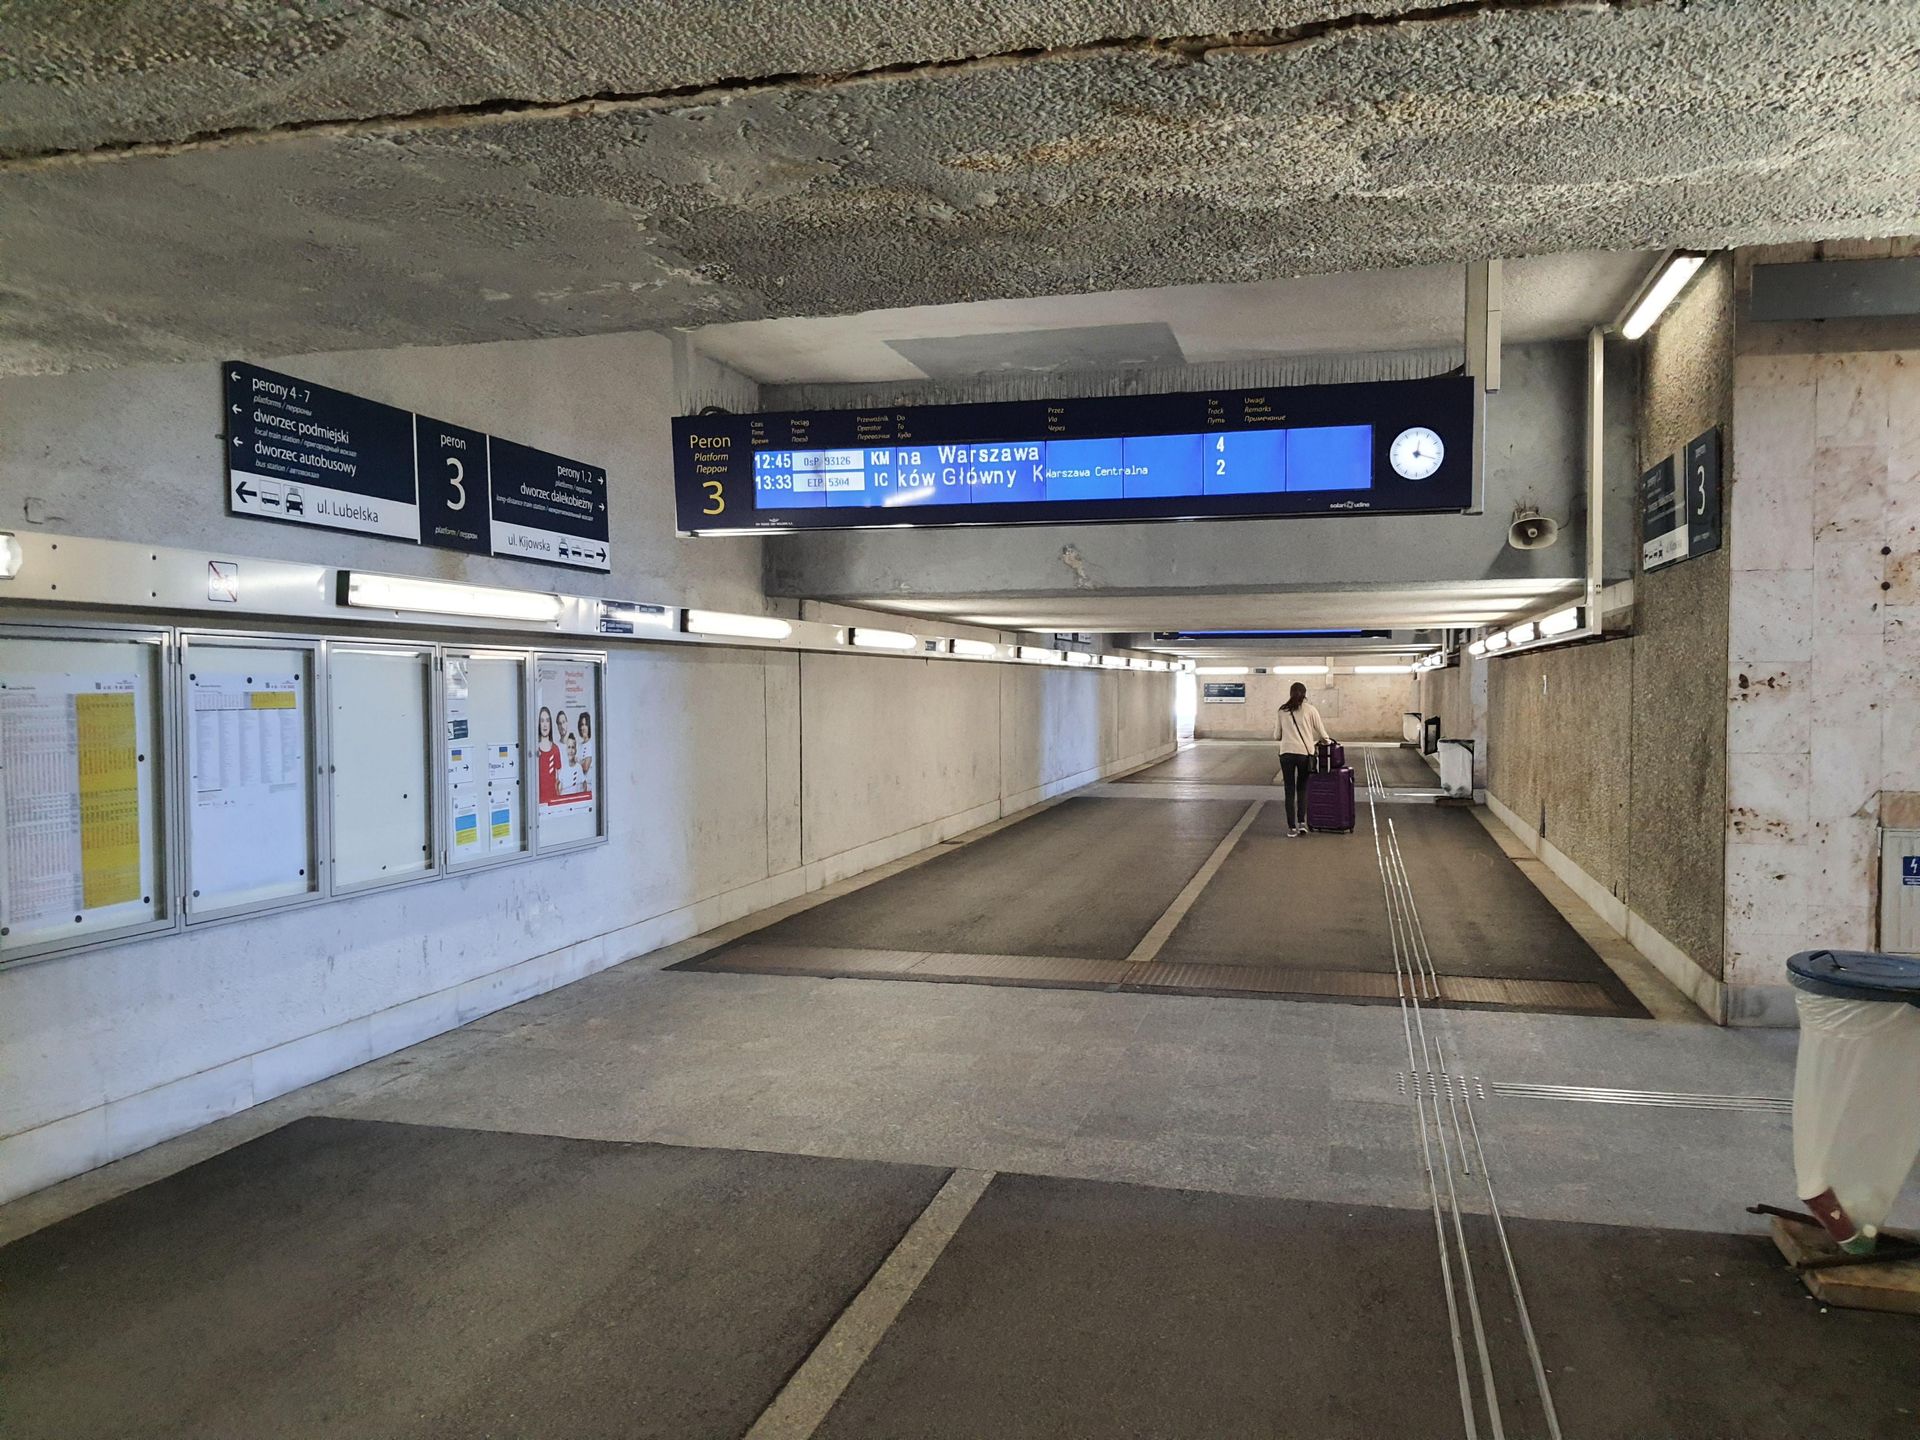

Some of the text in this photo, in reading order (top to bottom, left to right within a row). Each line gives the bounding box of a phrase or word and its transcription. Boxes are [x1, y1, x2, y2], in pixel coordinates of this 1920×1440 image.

[252, 378, 288, 400] perony
[289, 386, 296, 400] 4
[304, 390, 311, 403] 7
[1208, 407, 1224, 415] Track
[1244, 397, 1265, 405] Uwagi
[253, 408, 349, 444] dworzec podmiejski
[440, 434, 466, 450] peron
[690, 434, 731, 449] Peron
[254, 440, 357, 477] dworzec autobusowy
[694, 452, 729, 462] Platform
[755, 453, 791, 469] 12:45
[824, 456, 851, 465] 93126
[870, 451, 890, 465] KM
[898, 451, 921, 465] na
[938, 446, 1039, 464] Warszawa
[1216, 436, 1225, 452] 4
[557, 466, 580, 482] perony
[696, 464, 728, 475] Перрон
[755, 459, 1226, 490] 13:33 EIP 5304 IC ków Główny K Warszawa Centralna 2
[446, 457, 466, 511] 3
[520, 482, 550, 500] dworzec
[1697, 465, 1706, 516] 3
[702, 480, 725, 515] 3
[317, 500, 379, 523] ul. Lubelska
[508, 536, 550, 551] ul. Kijowska
